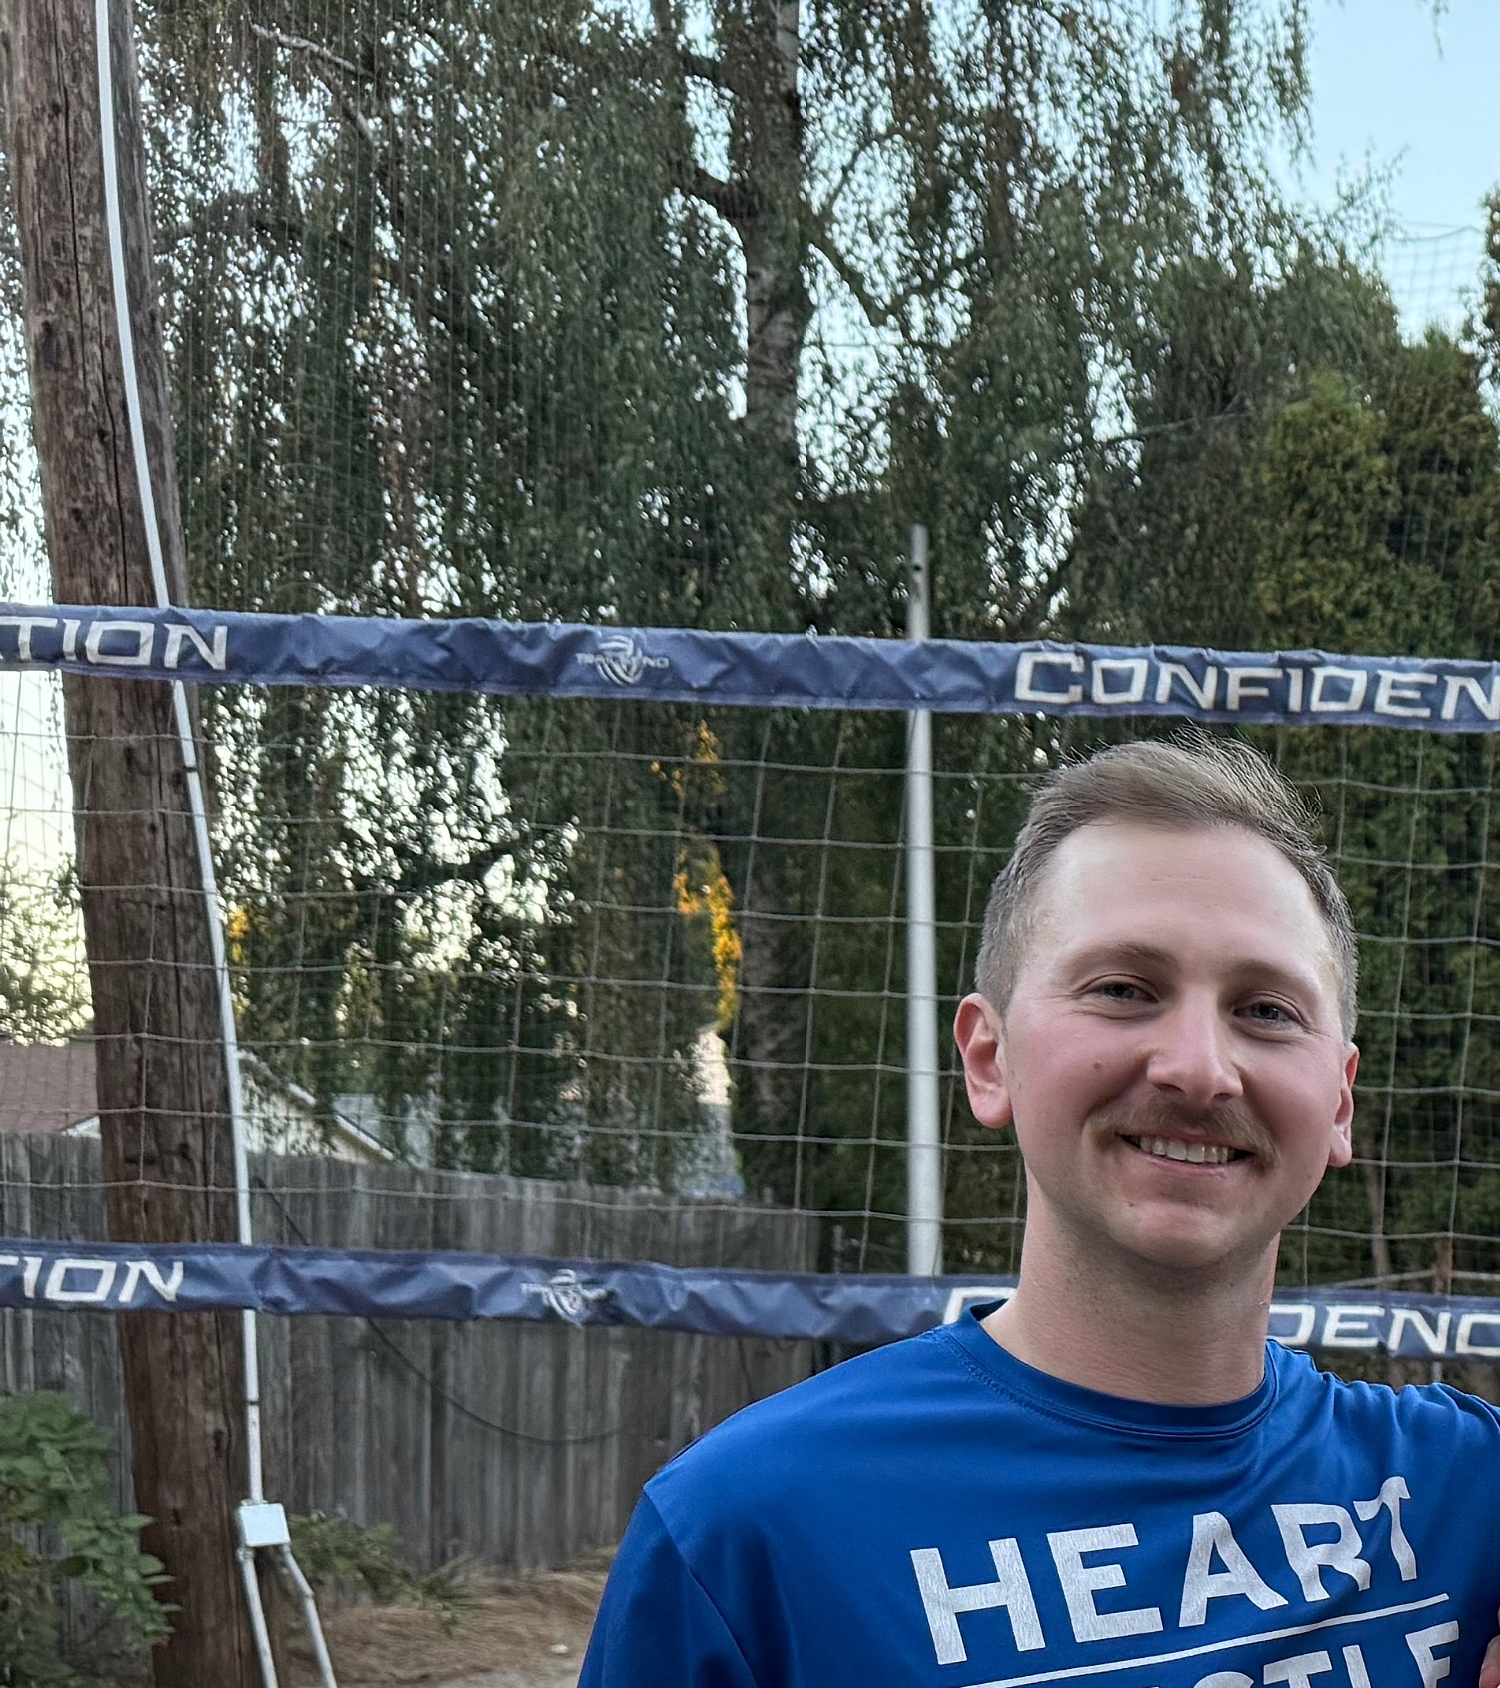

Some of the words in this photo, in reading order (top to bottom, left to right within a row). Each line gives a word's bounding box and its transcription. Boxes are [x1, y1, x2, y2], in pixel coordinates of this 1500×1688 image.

[0, 616, 228, 671] TION
[0, 1255, 183, 1302] ION
[909, 1476, 1417, 1665] HEART
